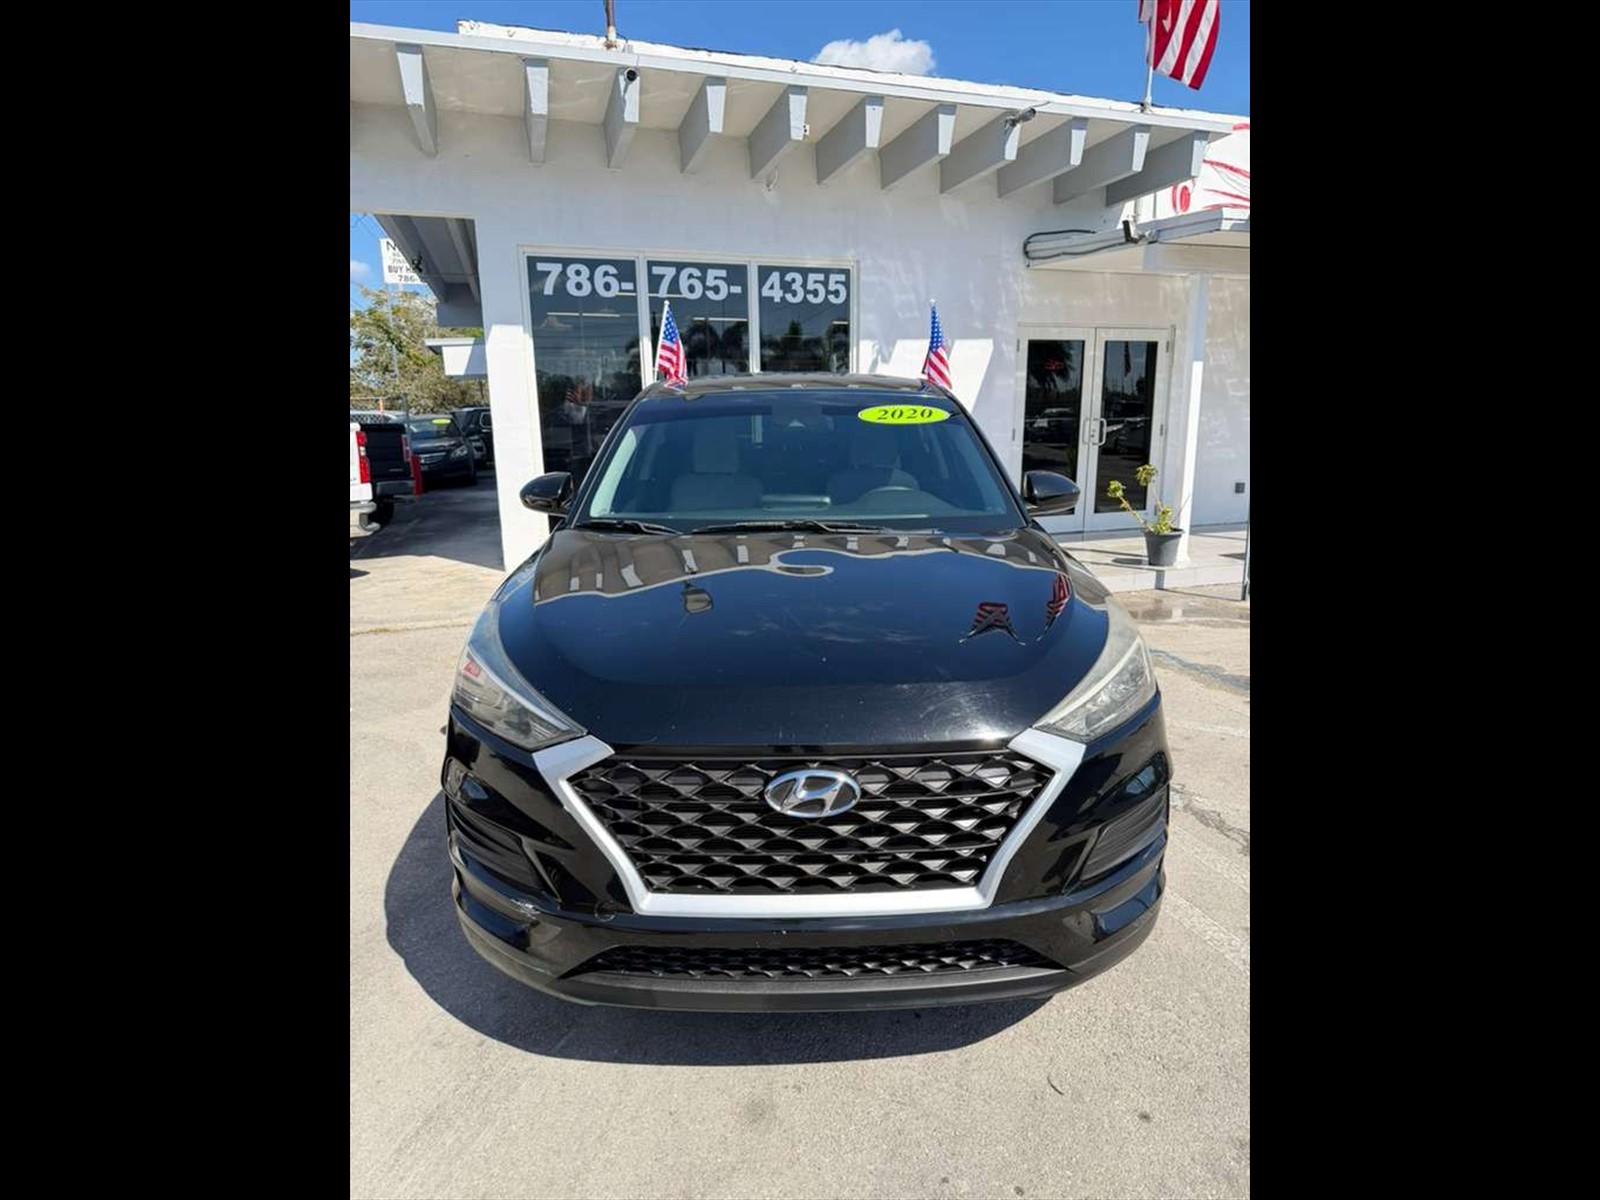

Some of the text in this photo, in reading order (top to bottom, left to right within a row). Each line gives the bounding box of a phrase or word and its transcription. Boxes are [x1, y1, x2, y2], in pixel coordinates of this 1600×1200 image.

[387, 265, 404, 274] BUY
[536, 262, 848, 304] 786- 765- 4355
[876, 408, 933, 421] 2020
